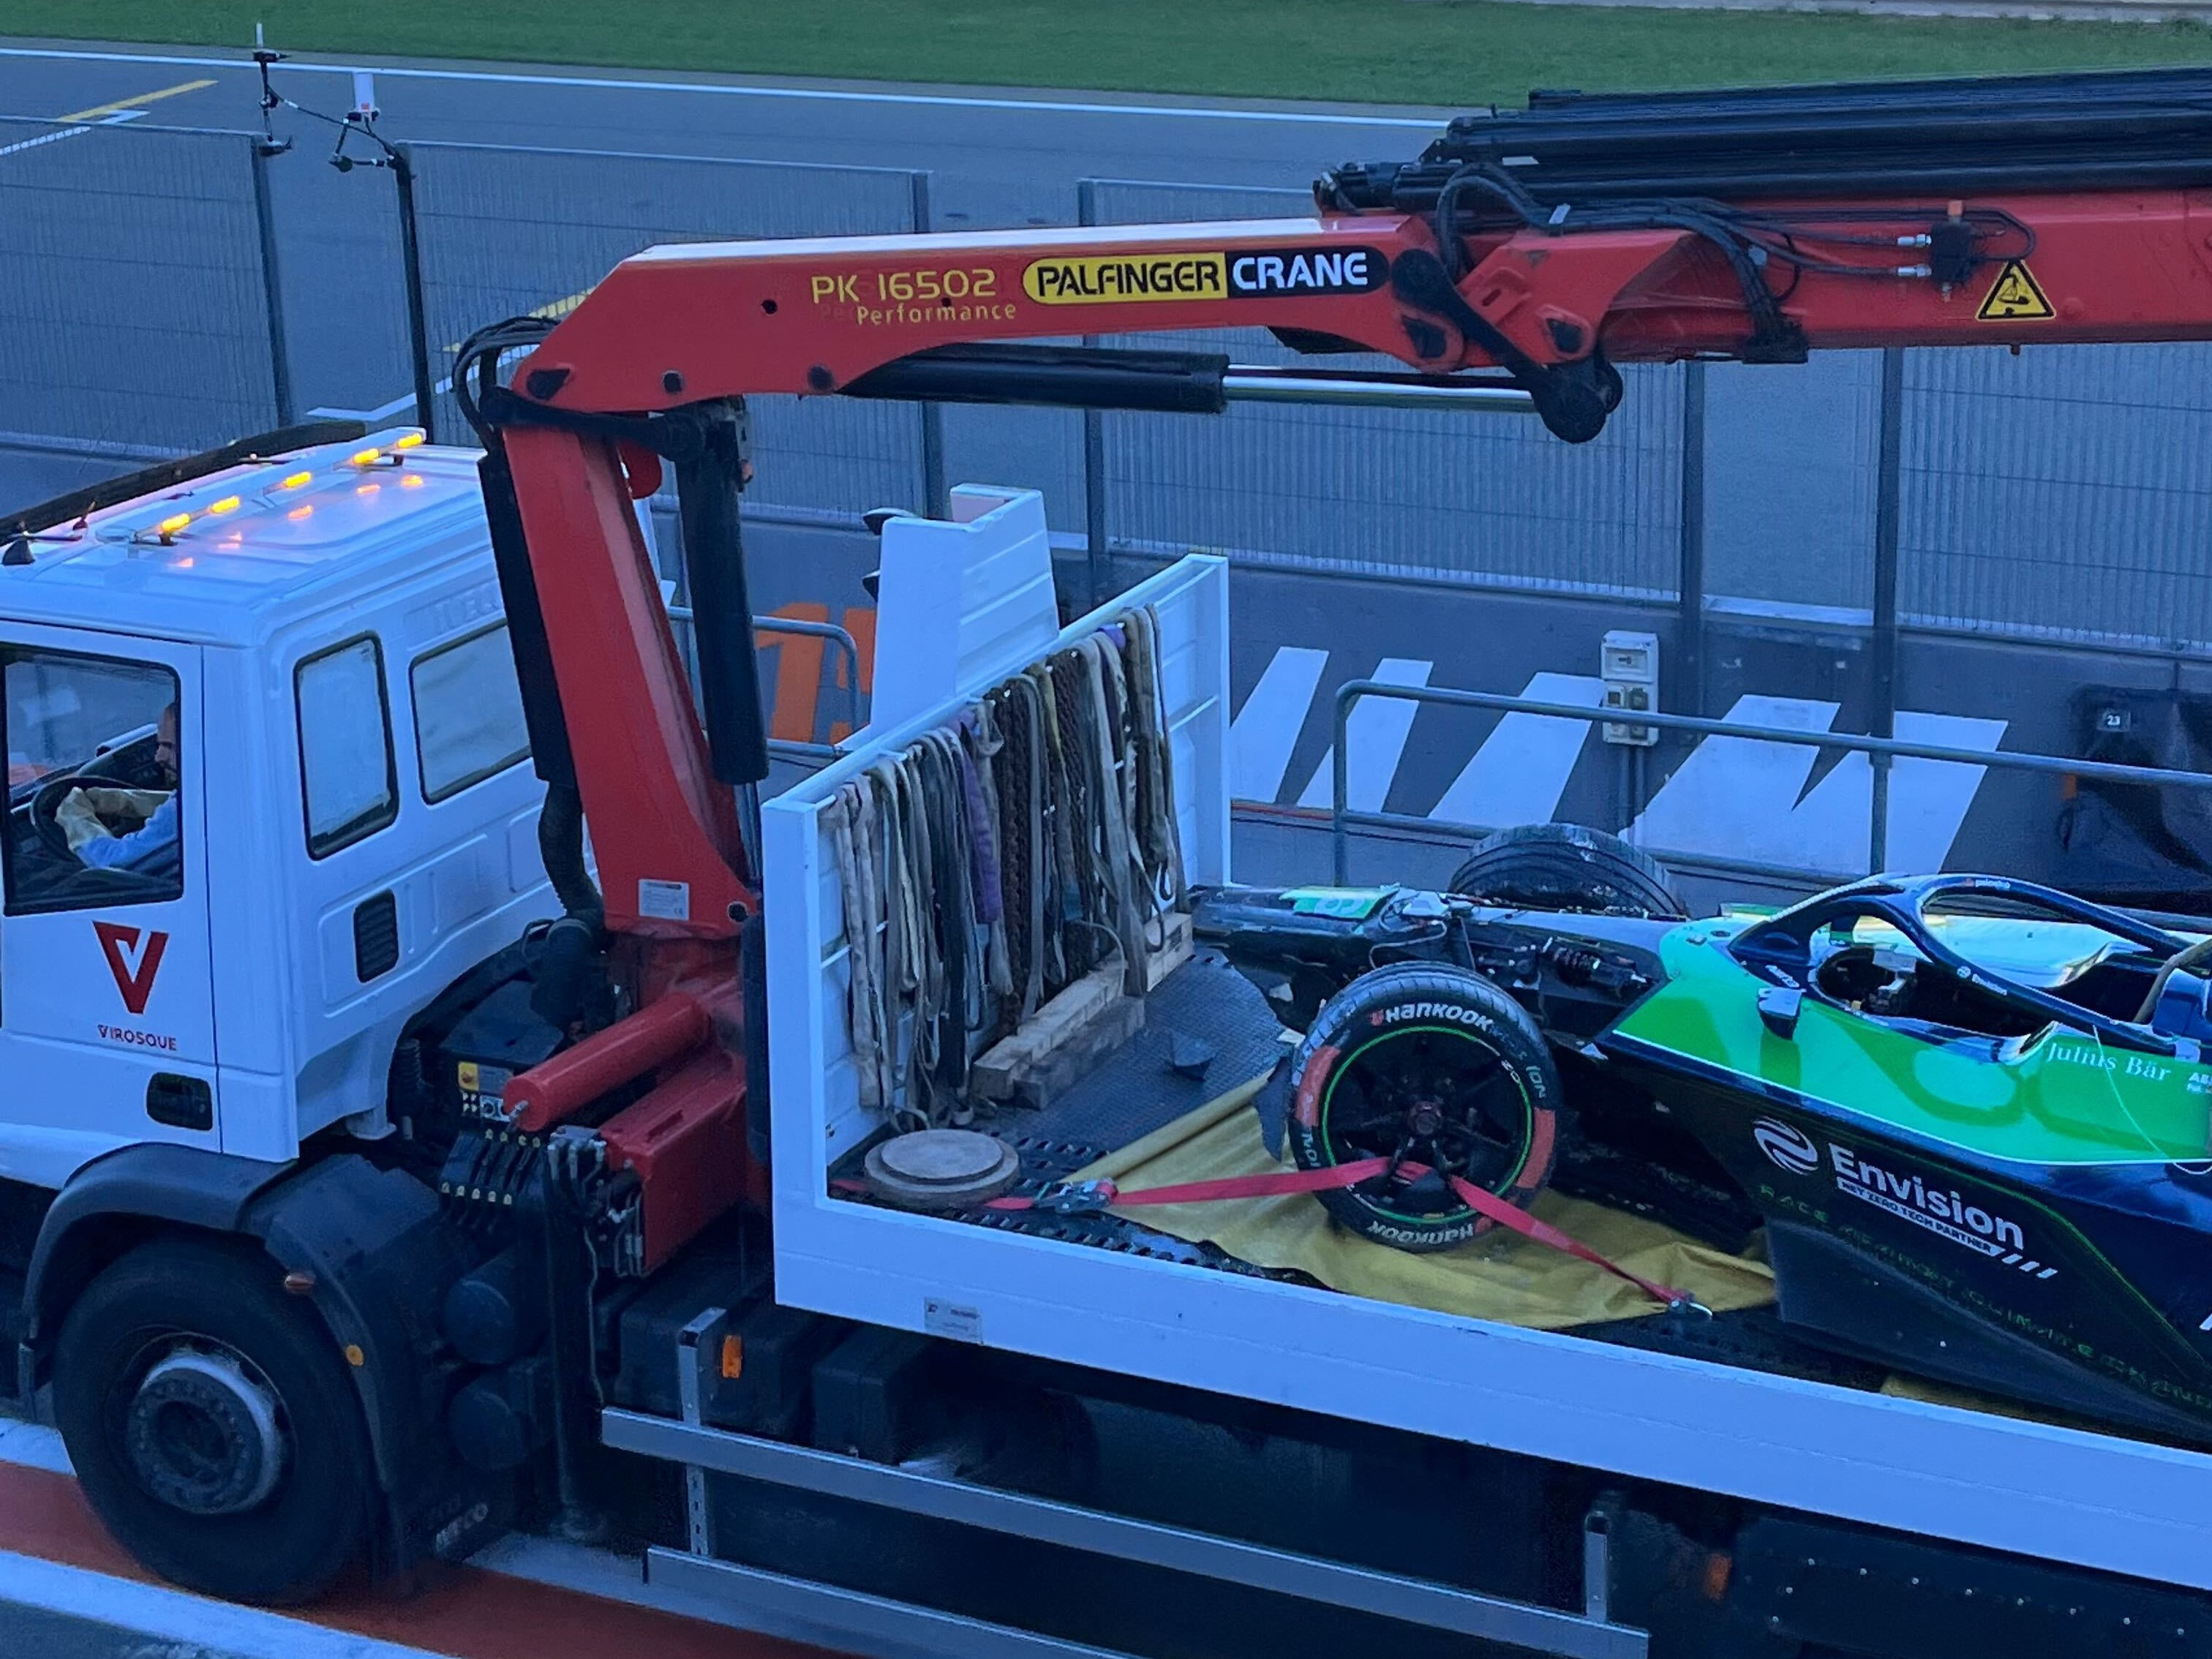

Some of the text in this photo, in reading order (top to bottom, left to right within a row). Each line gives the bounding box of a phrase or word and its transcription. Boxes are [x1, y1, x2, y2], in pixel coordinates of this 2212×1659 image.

[811, 268, 996, 304] PK 16502
[1037, 260, 1221, 297] PALFINGER
[1232, 252, 1368, 290] CRANE
[857, 302, 1017, 326] Performance
[97, 1024, 177, 1051] VIROSQUE
[2046, 1042, 2172, 1081] Julius Bär
[1829, 1142, 2024, 1250] Envision
